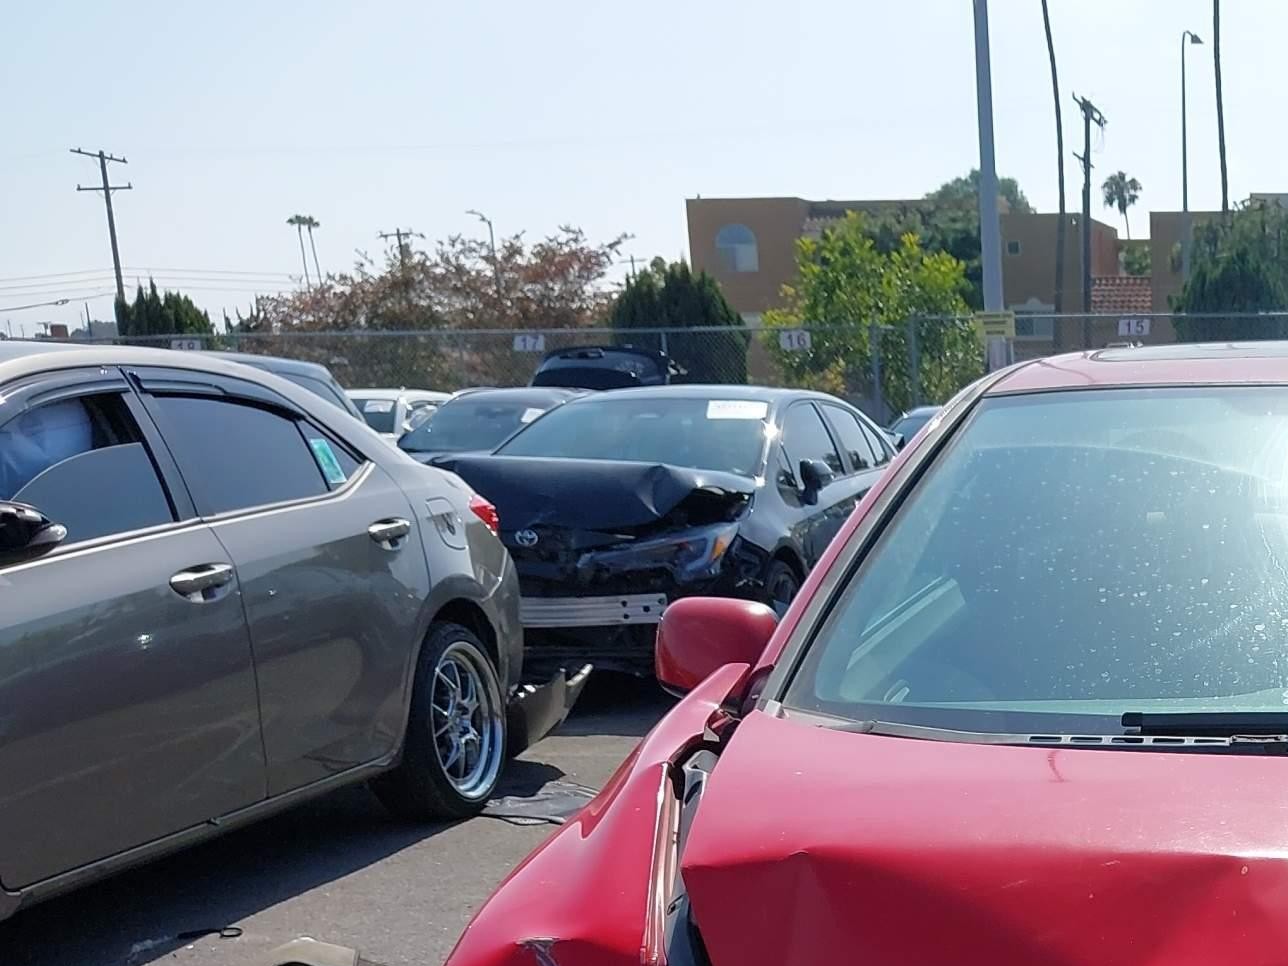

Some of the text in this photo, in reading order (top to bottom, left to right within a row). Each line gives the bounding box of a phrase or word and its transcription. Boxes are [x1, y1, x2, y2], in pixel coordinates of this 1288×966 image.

[1126, 319, 1144, 335] 15
[521, 335, 539, 350] 17
[788, 332, 806, 348] 16
